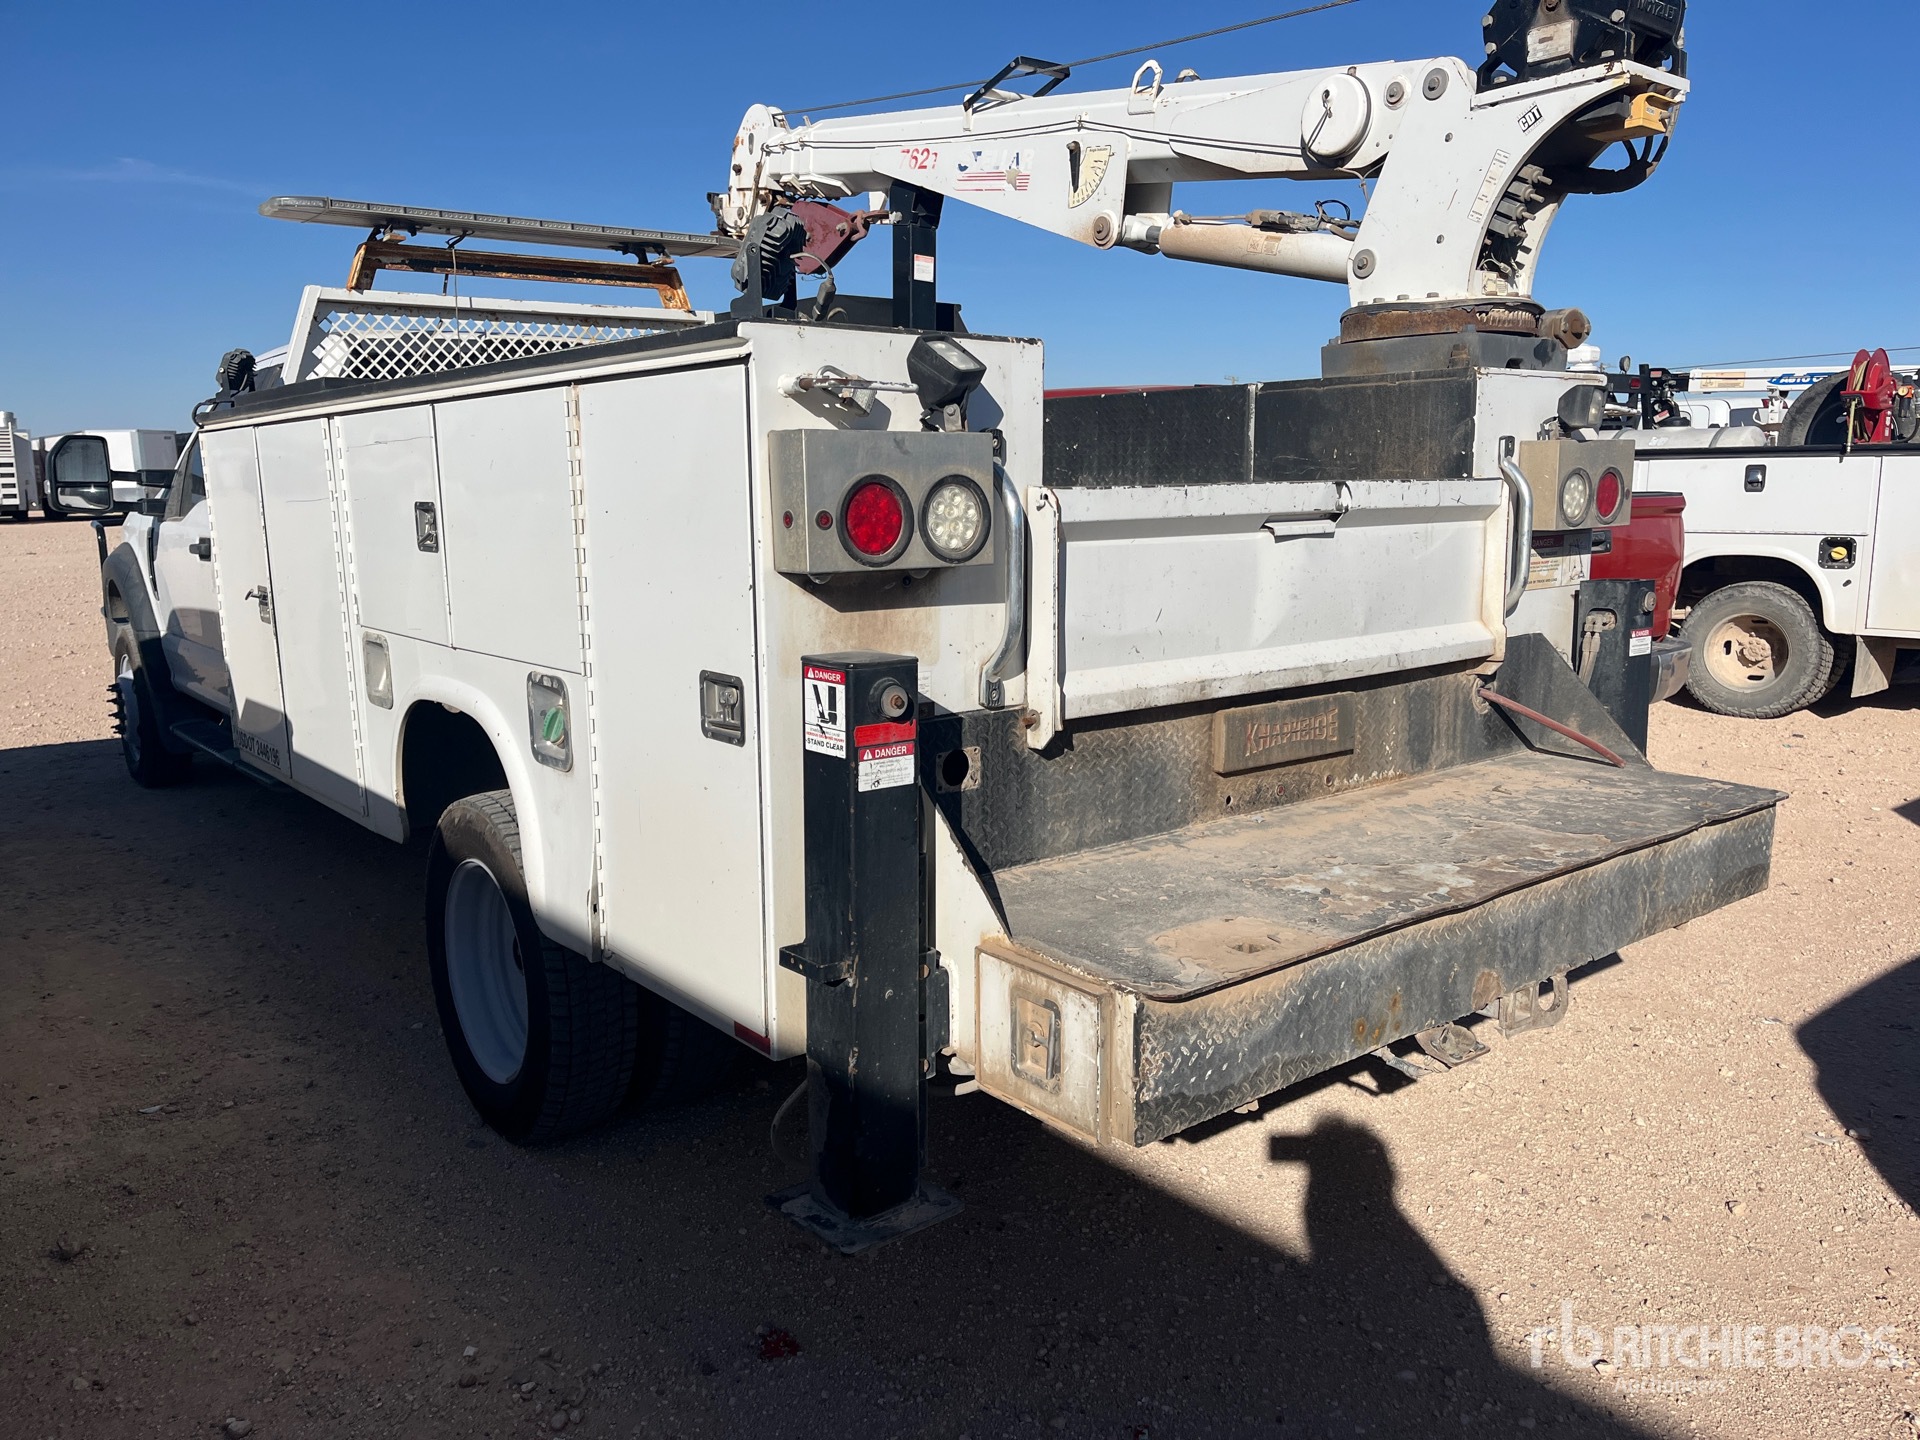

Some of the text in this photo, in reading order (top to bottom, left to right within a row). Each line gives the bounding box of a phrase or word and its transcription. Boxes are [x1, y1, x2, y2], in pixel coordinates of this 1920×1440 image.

[1519, 106, 1542, 131] CDT
[814, 670, 842, 683] DANGER
[1245, 707, 1338, 757] KNAPHEIDE
[807, 737, 844, 752] STAND CLEAR
[875, 745, 907, 759] DANGER
